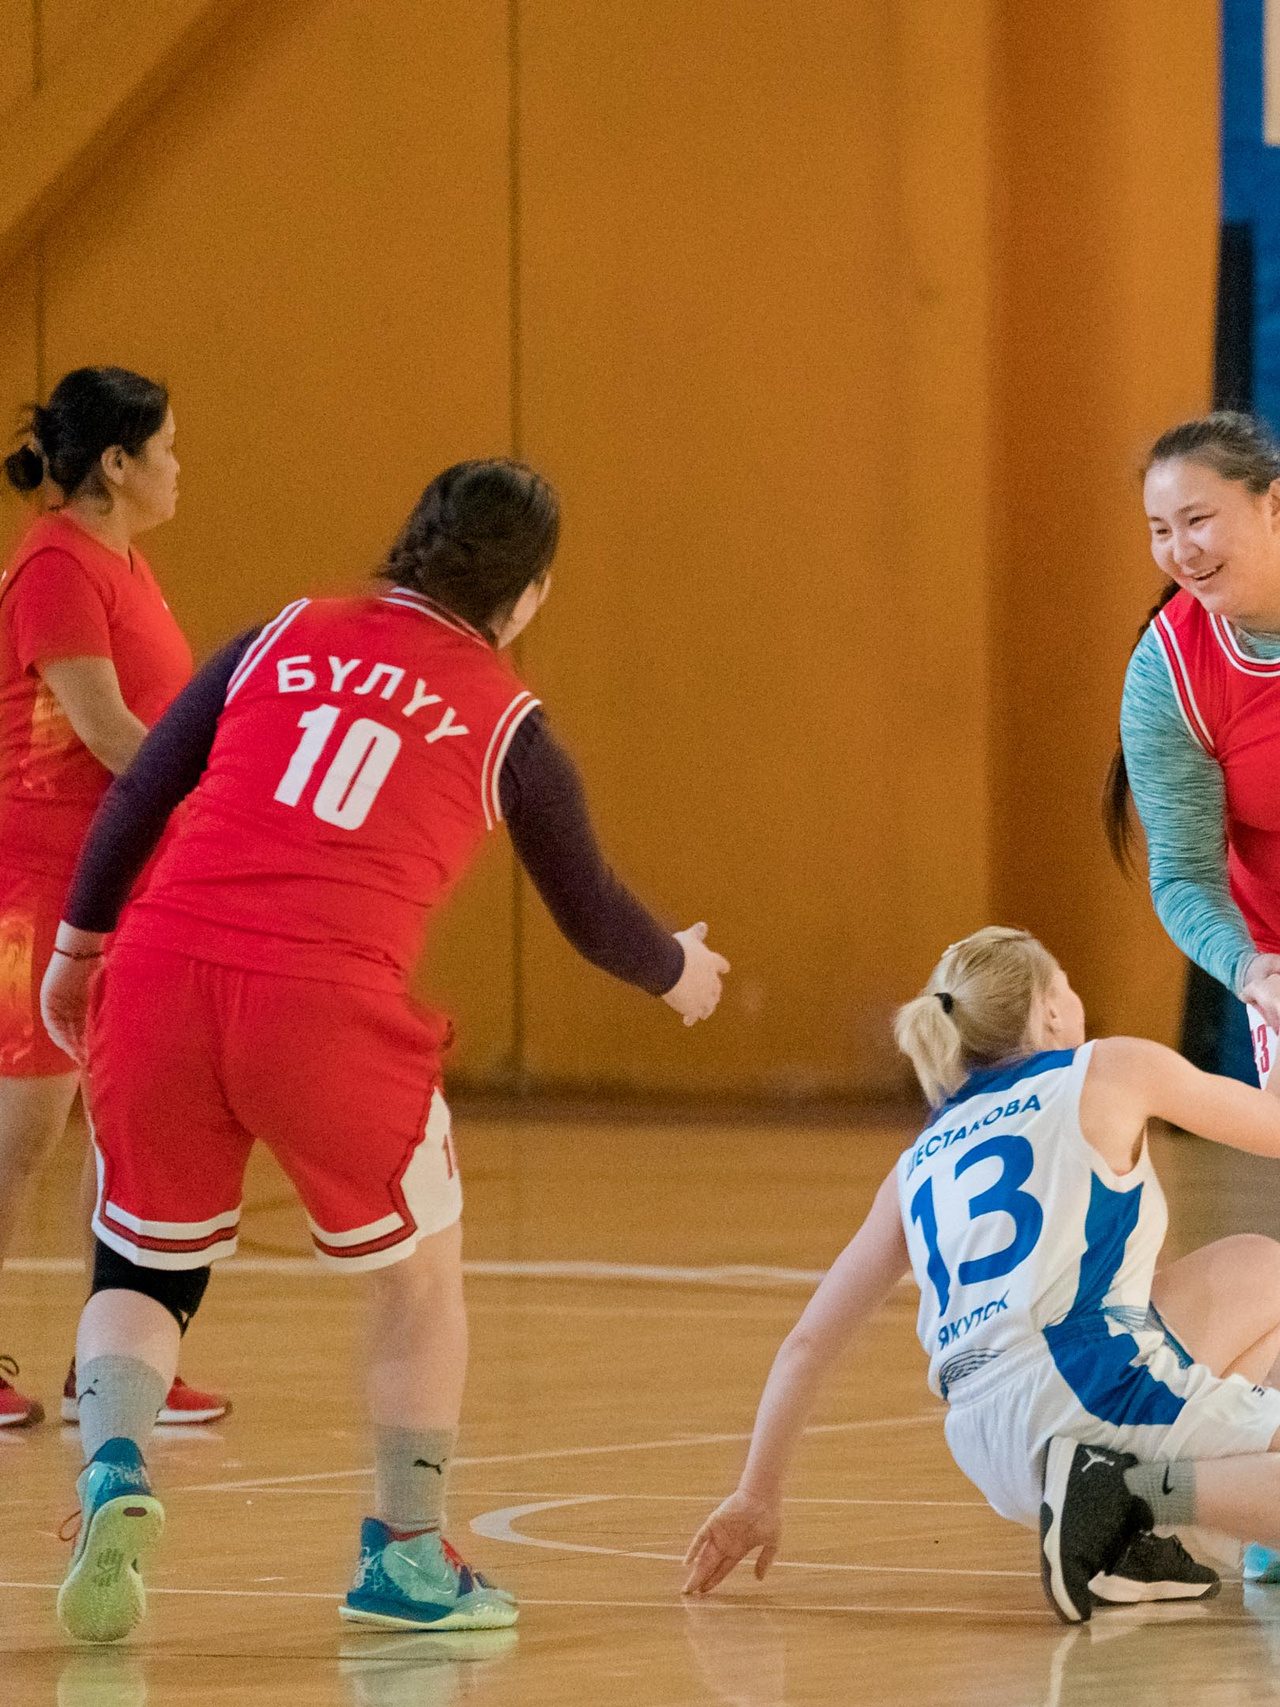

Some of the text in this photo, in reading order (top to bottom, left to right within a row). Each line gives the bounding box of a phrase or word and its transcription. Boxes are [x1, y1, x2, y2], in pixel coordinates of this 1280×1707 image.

[274, 704, 401, 830] 10
[907, 1094, 1042, 1181] ЕСТАКОВА
[911, 1135, 1043, 1317] 13
[938, 1289, 1010, 1351] ЯКУТСК
